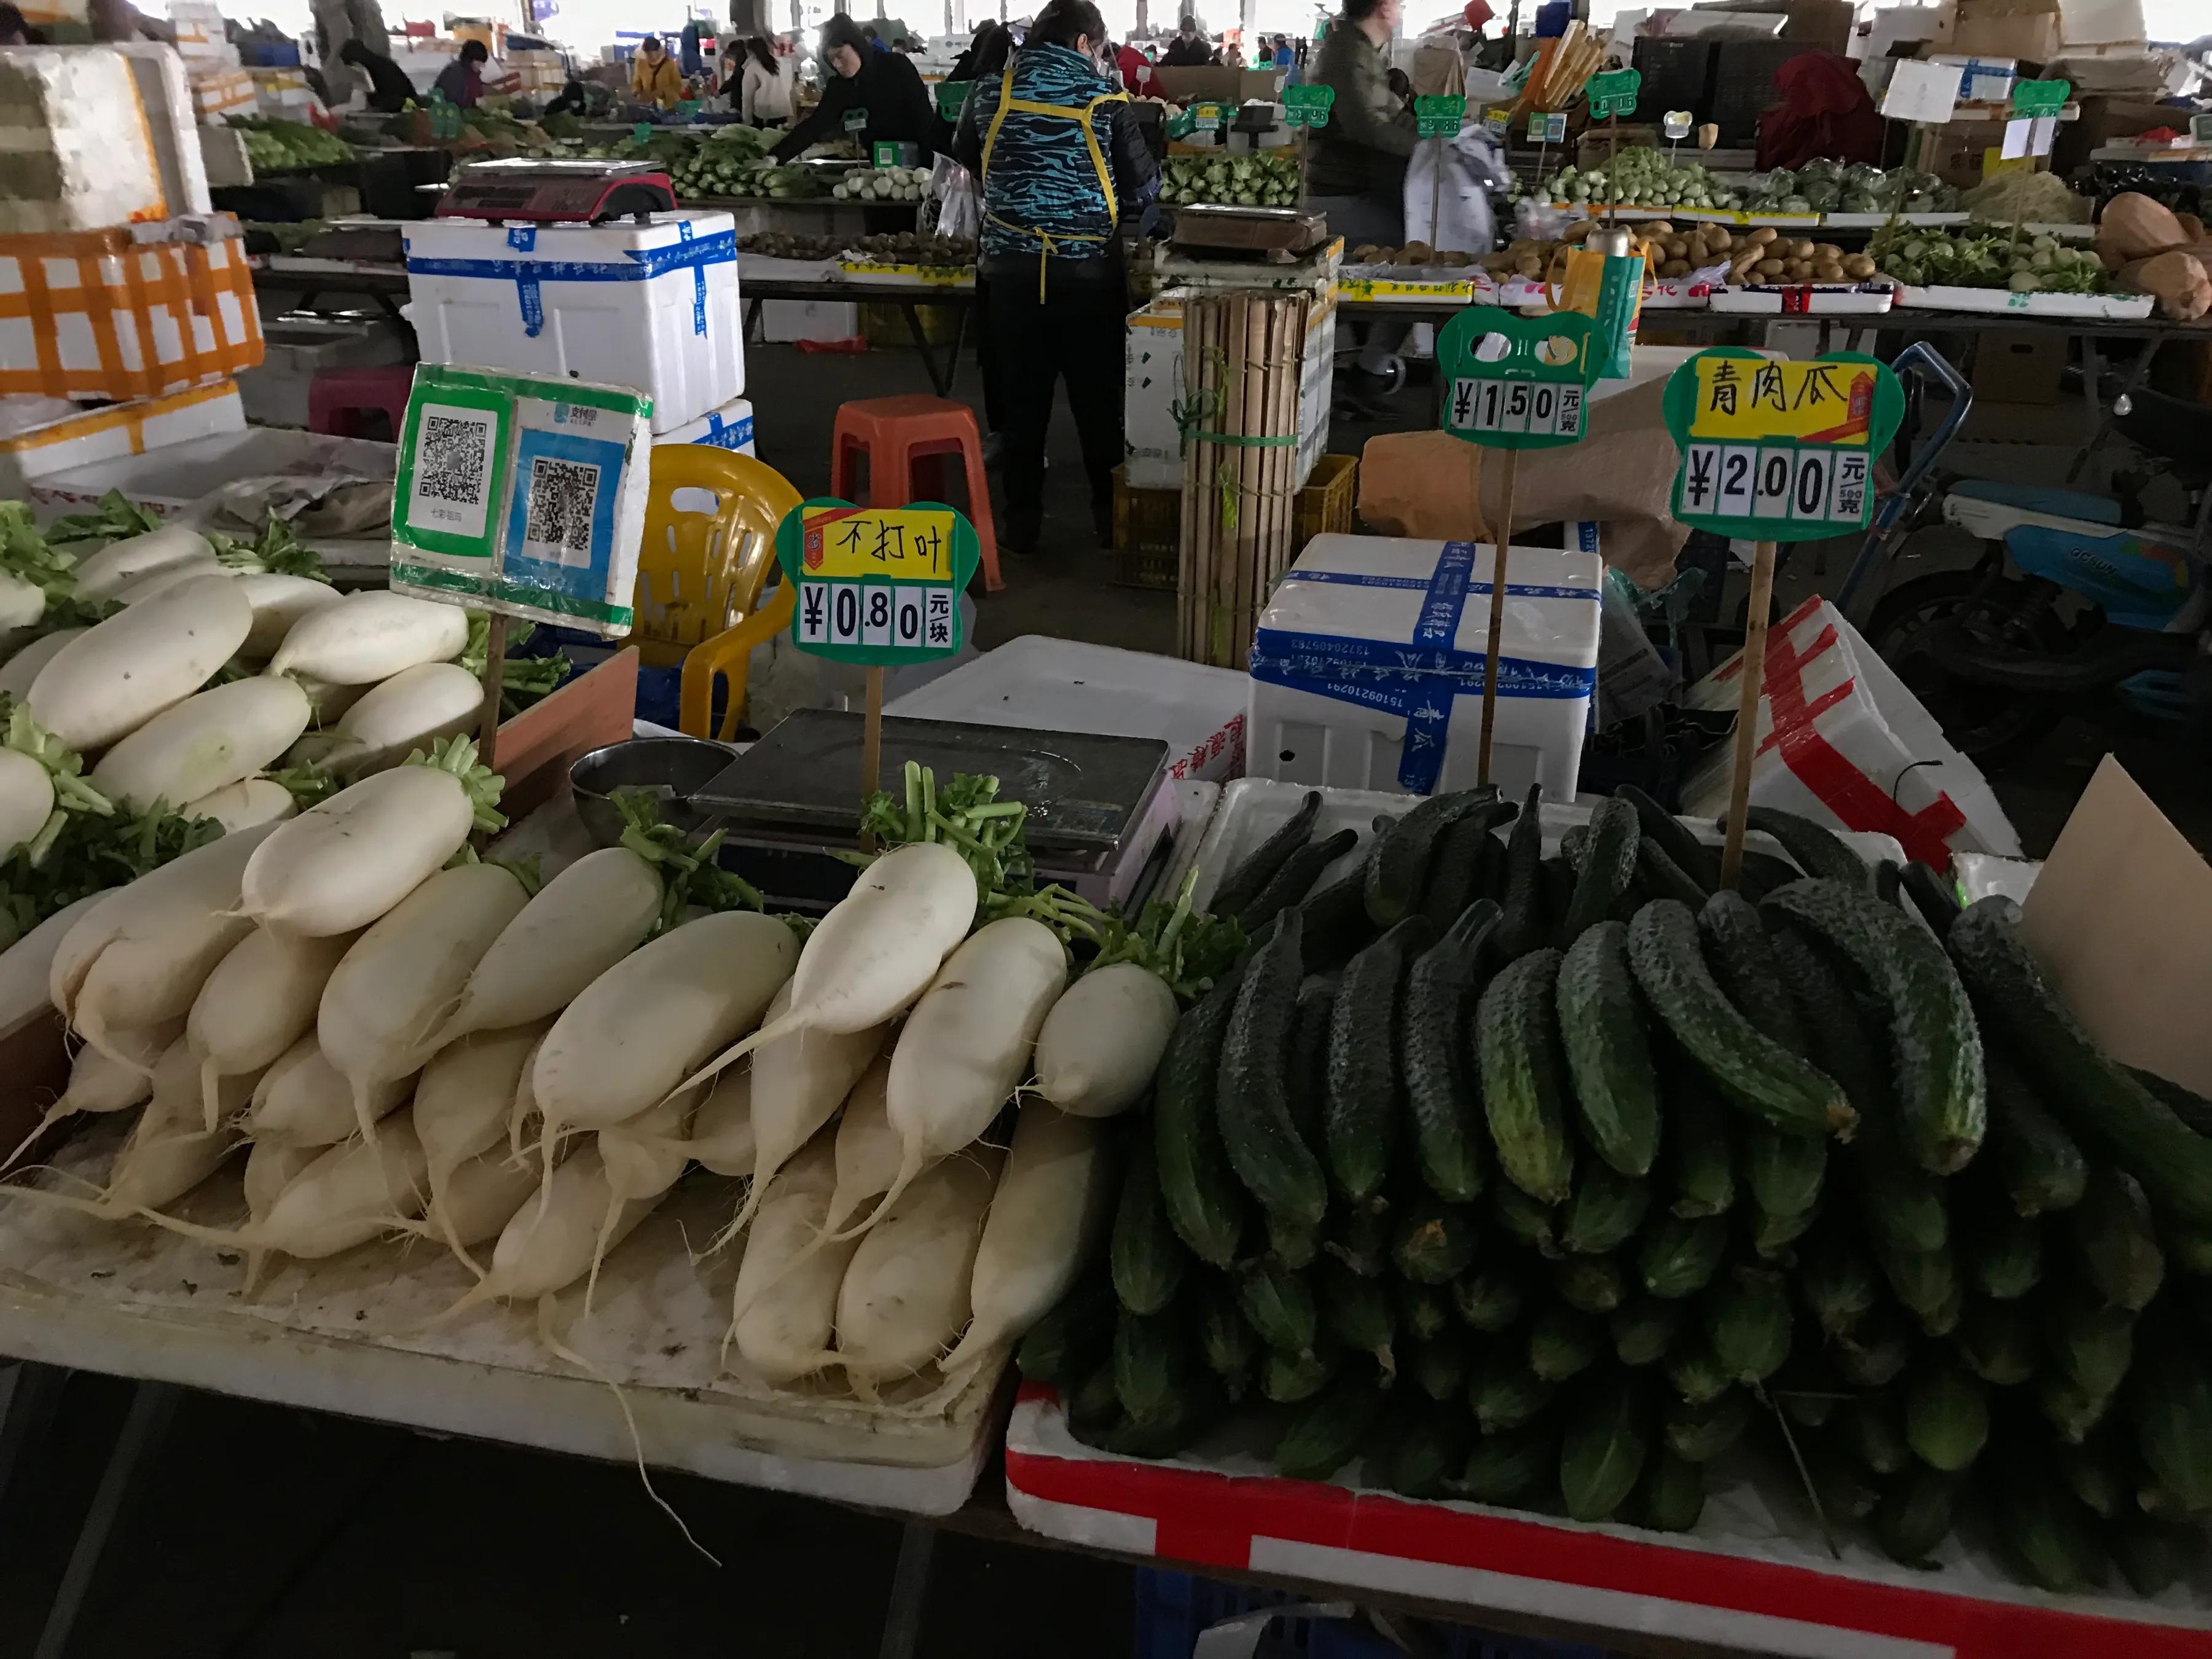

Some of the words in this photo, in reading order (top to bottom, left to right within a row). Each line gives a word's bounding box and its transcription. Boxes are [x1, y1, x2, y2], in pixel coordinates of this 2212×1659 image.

[1709, 359, 1848, 415] 青肉瓜
[836, 519, 943, 574] 不打叶
[1327, 683, 1403, 707] 15109210291
